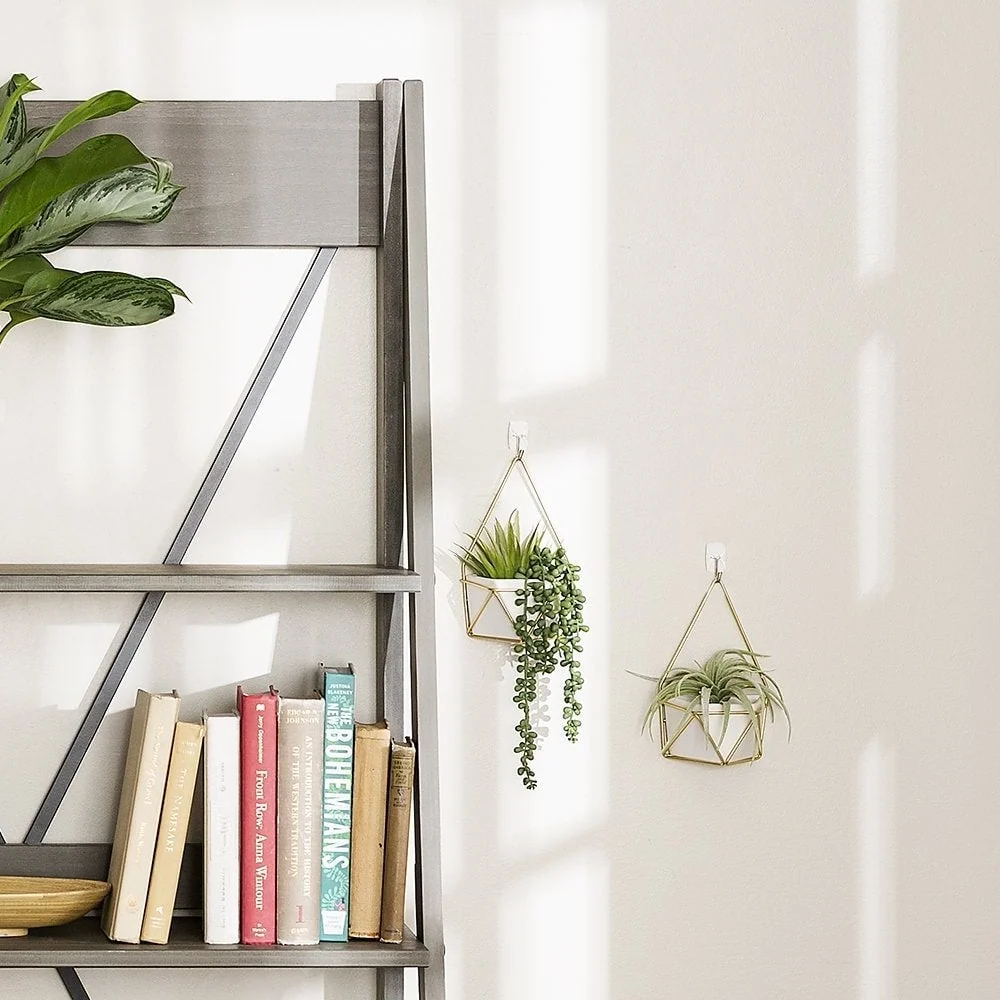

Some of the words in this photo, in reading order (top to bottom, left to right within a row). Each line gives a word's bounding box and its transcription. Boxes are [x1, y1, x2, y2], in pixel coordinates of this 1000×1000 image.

[327, 702, 340, 729] NEW
[341, 706, 352, 725] THE
[292, 746, 300, 758] OF
[305, 735, 312, 749] AN
[255, 769, 268, 800] Front
[291, 760, 299, 780] THE
[304, 751, 312, 818] INTRODUCTION
[291, 782, 300, 827] WESTERN
[321, 729, 353, 869] BOHEMIANS
[166, 795, 183, 853] NAMESAKE
[255, 803, 268, 830] Row:
[304, 820, 312, 834] TO
[255, 833, 268, 863] Anna
[290, 829, 299, 878] TRADITION
[303, 836, 311, 856] THE
[255, 865, 268, 911] Wintour
[303, 858, 311, 896] HISTORY
